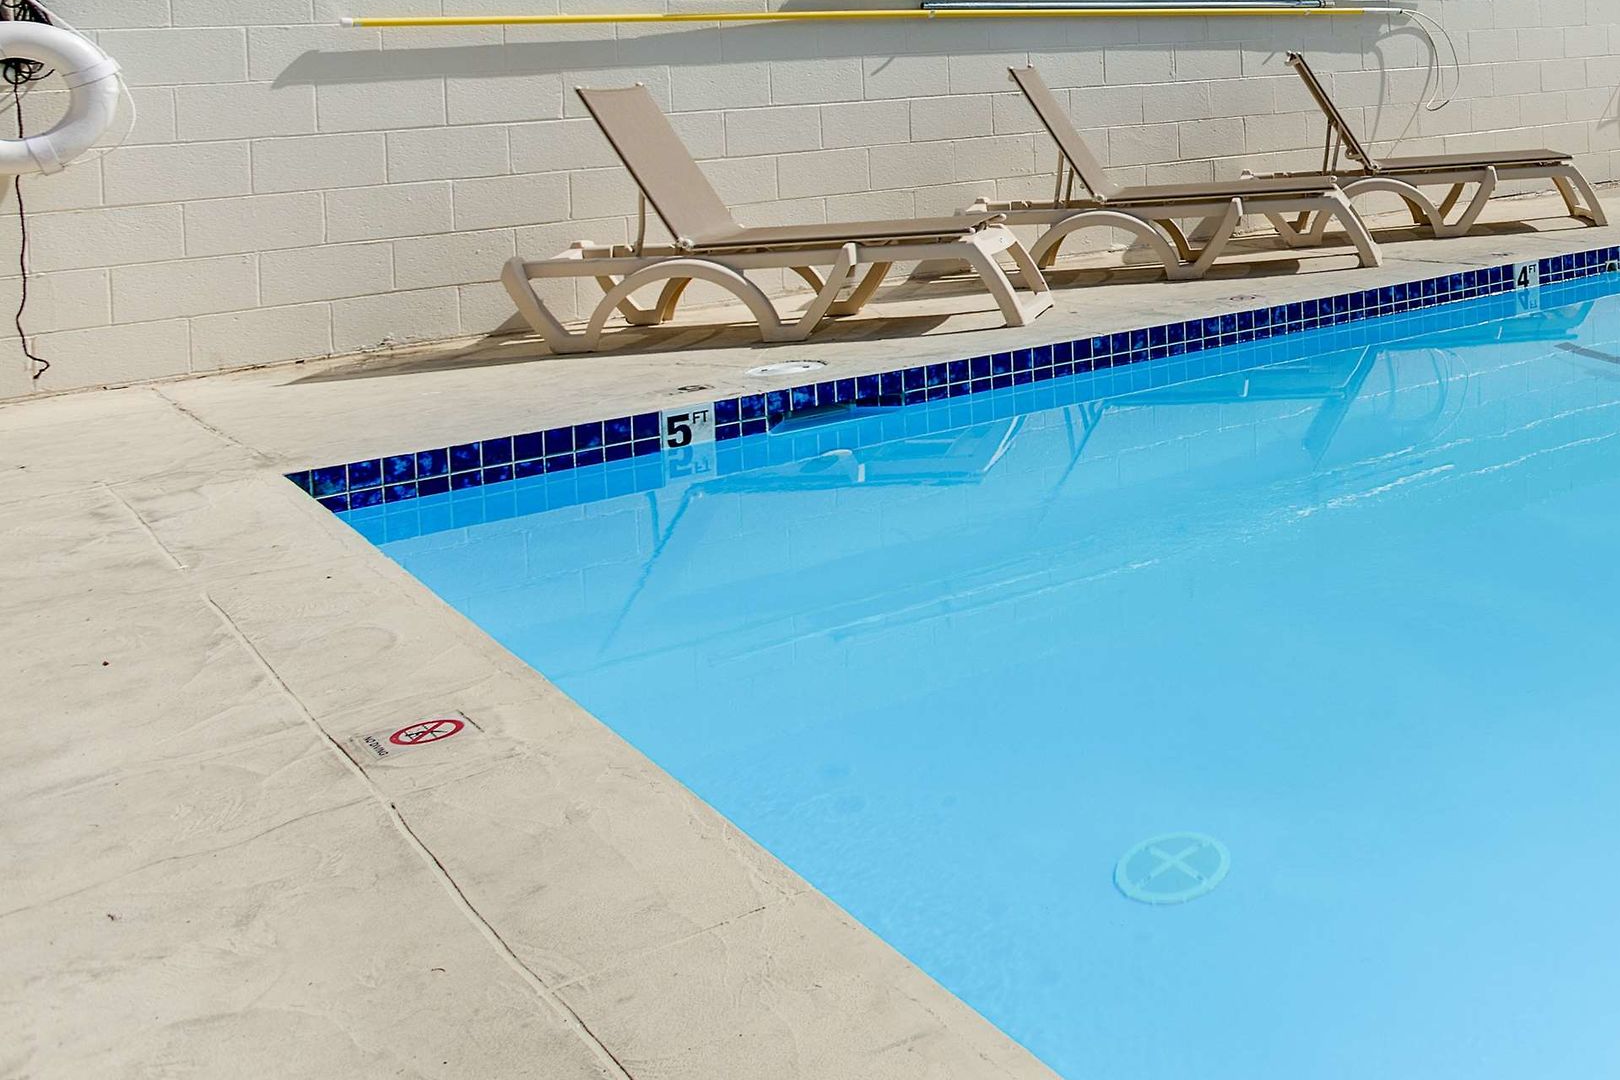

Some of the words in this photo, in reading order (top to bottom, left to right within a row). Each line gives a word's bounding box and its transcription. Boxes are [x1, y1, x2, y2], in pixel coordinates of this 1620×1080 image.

[1517, 265, 1530, 287] 4
[1528, 263, 1537, 273] FT
[667, 413, 692, 448] 5
[692, 409, 709, 424] FT
